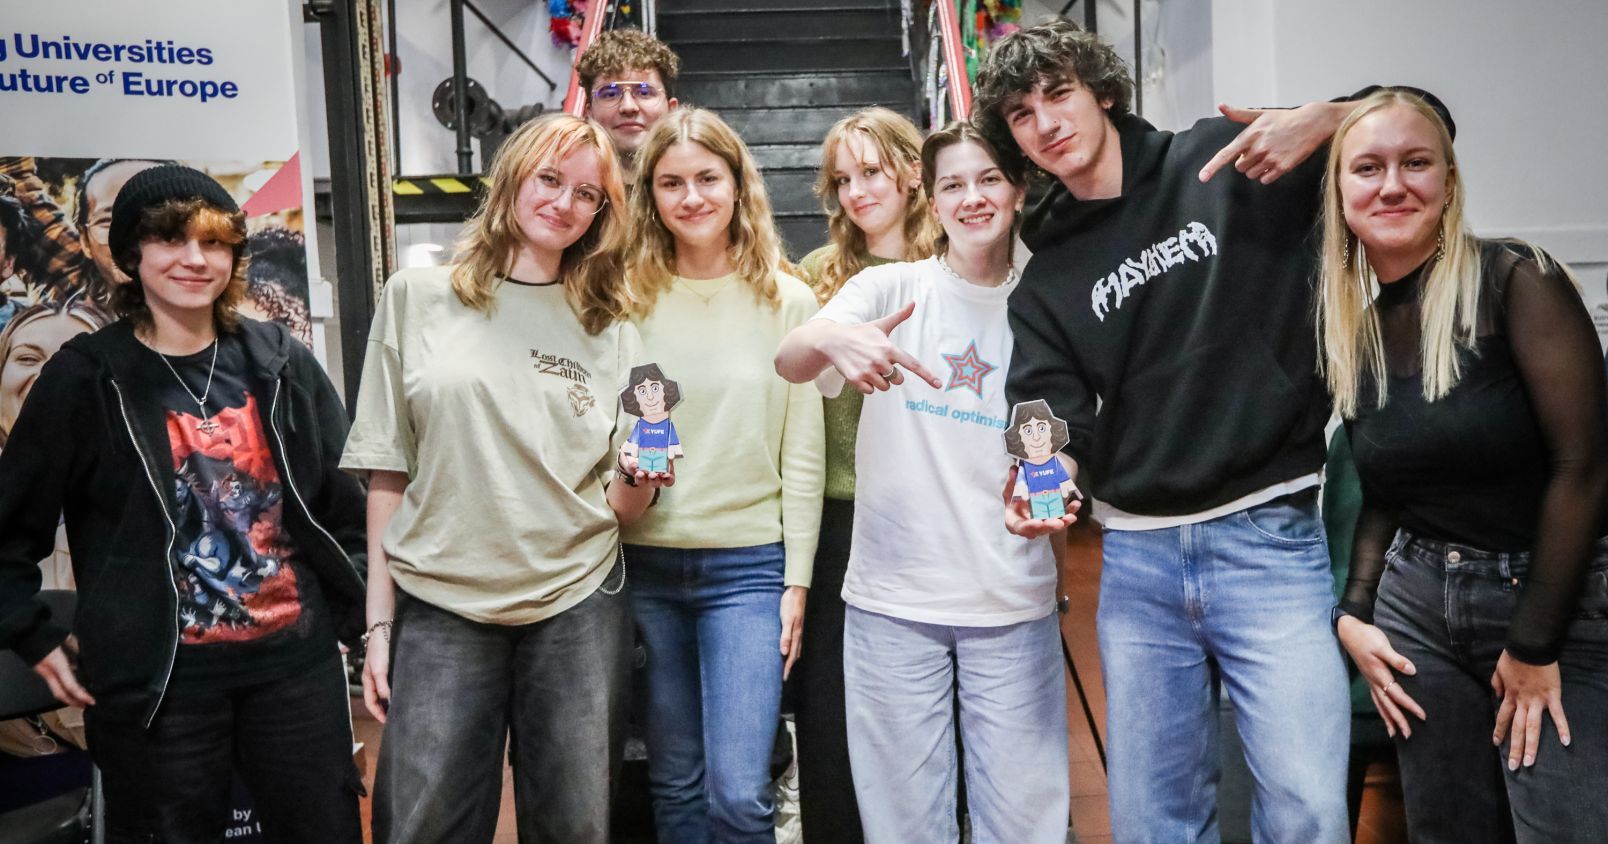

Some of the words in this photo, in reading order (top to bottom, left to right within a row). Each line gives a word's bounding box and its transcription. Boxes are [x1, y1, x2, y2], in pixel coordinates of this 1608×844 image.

[14, 33, 214, 66] Universities
[96, 70, 115, 85] of
[122, 72, 239, 103] Europe
[1091, 221, 1218, 323] MAYHEM
[538, 360, 587, 384] Zaun
[906, 399, 948, 418] radical
[951, 408, 1008, 431] optimis
[233, 808, 252, 822] by
